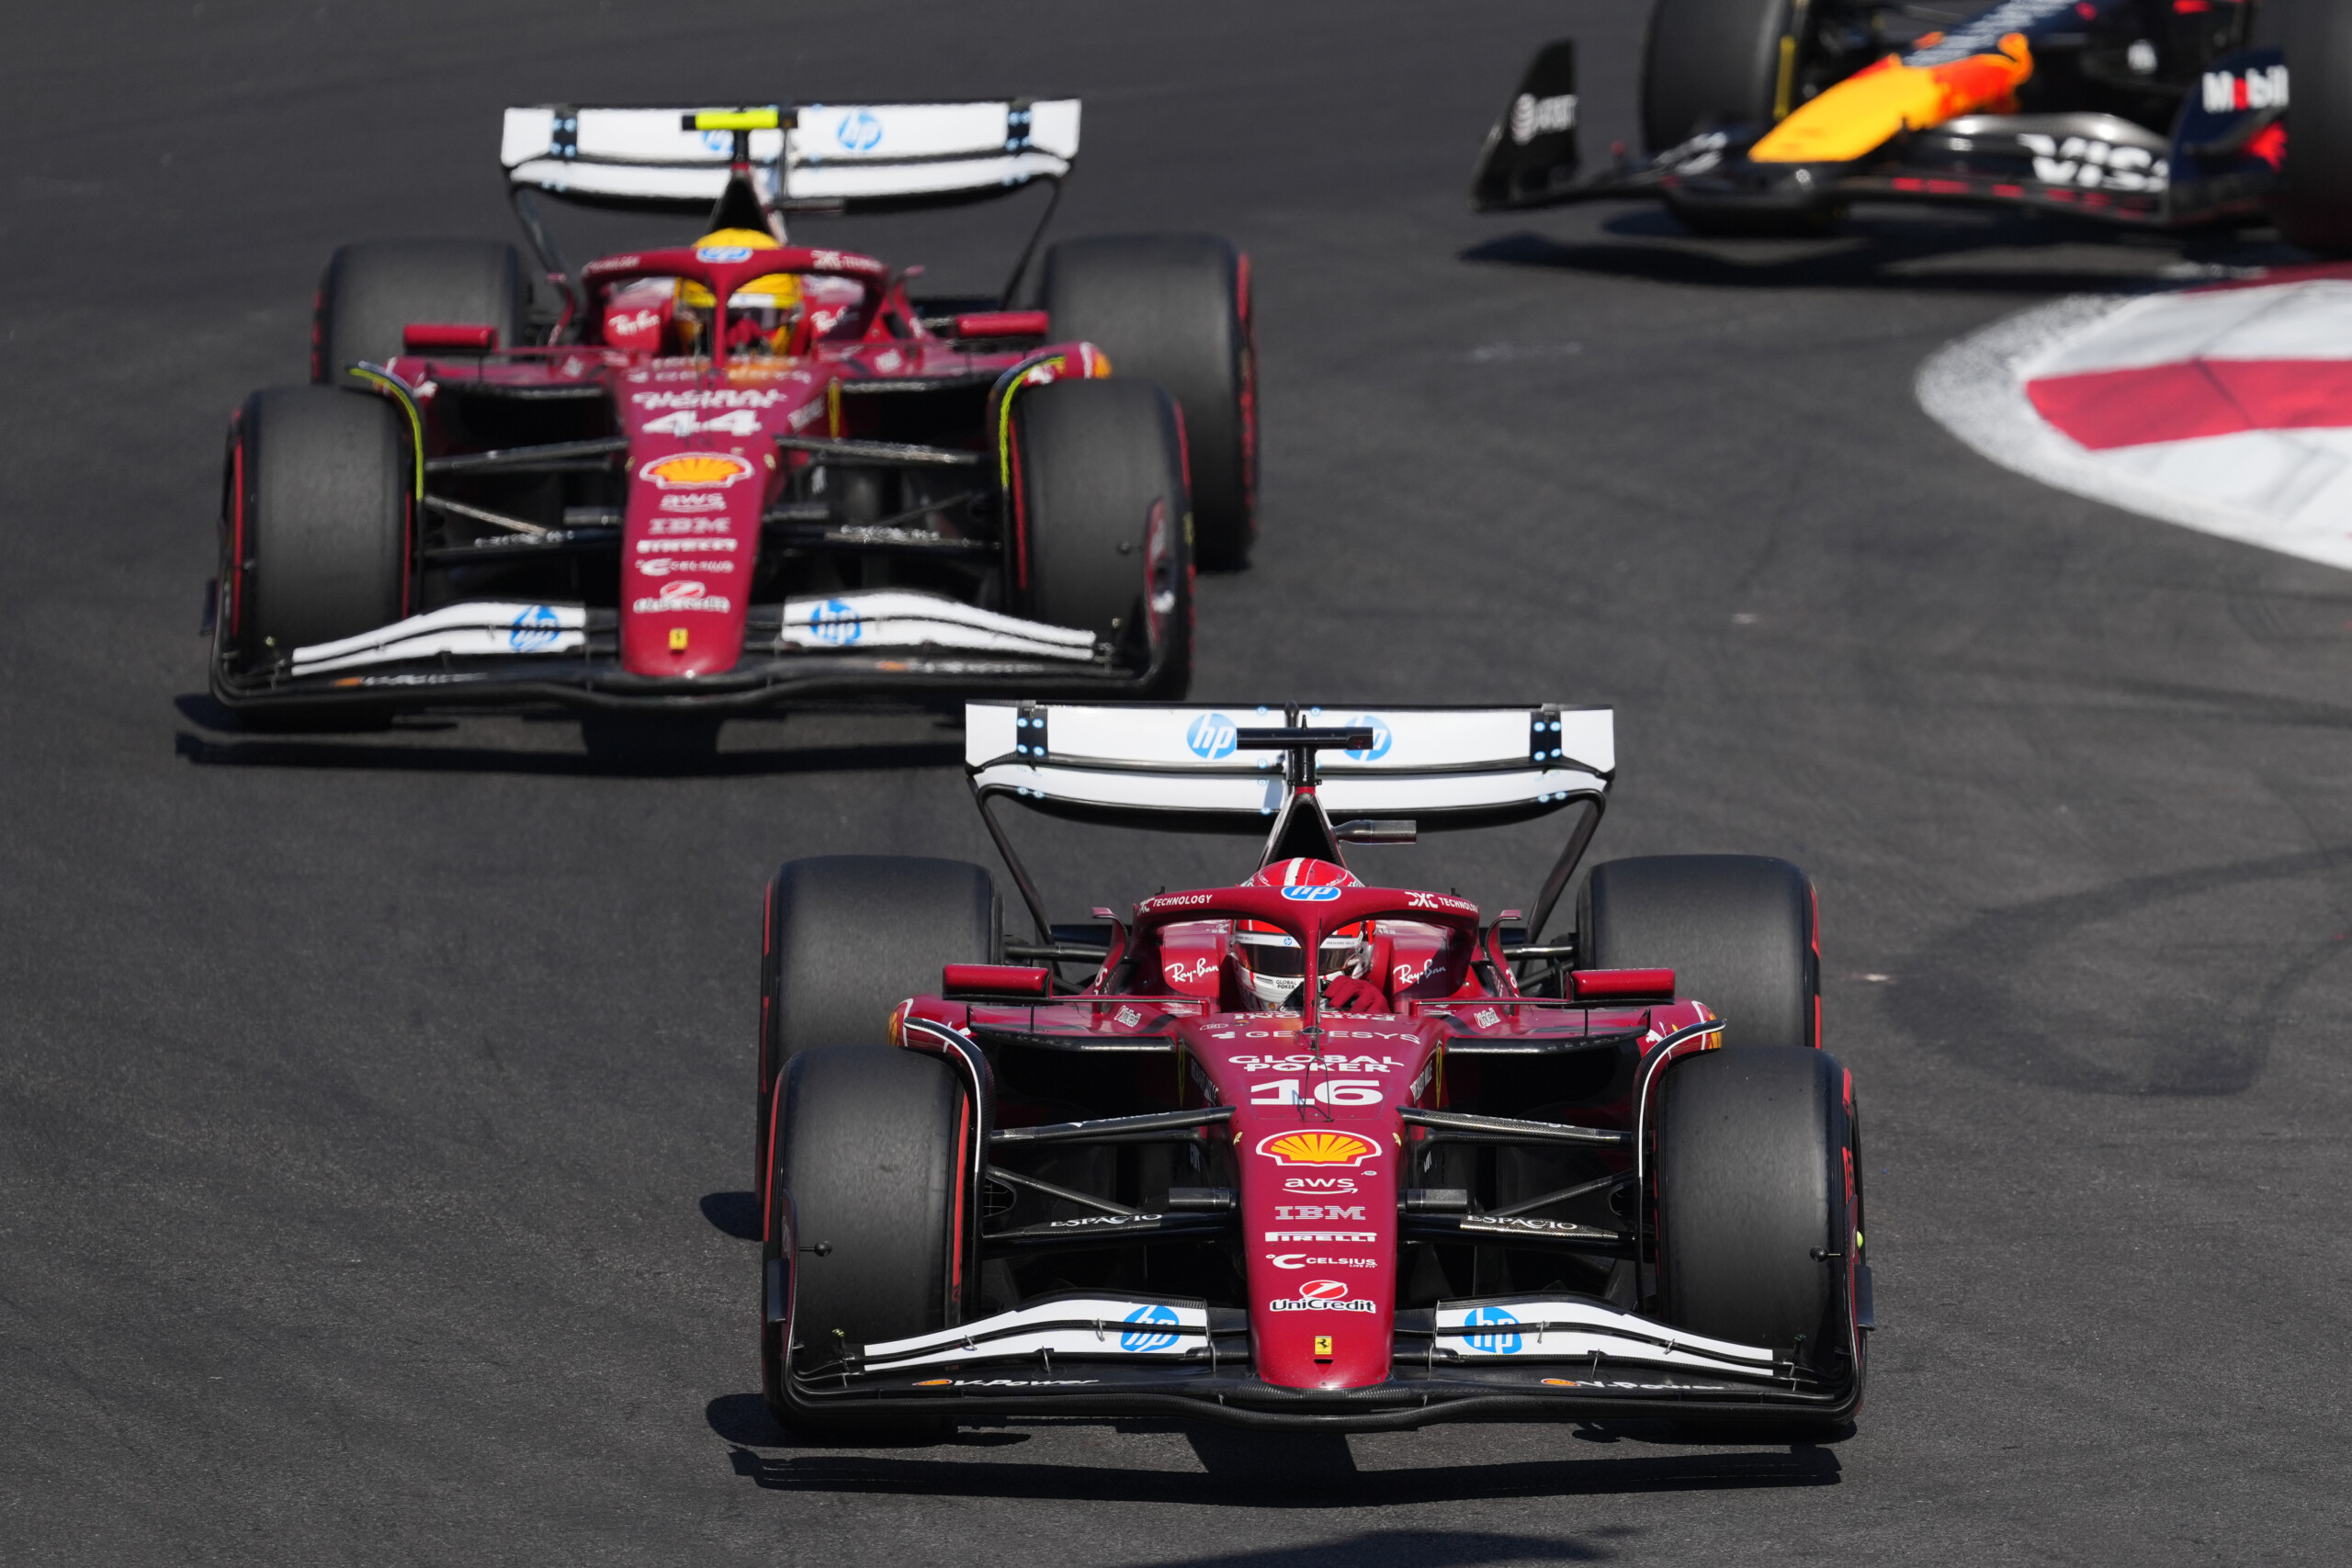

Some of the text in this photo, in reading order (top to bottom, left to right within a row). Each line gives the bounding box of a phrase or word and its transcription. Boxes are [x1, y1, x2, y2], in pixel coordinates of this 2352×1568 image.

[839, 111, 882, 151] hp
[642, 409, 763, 437] 44
[1188, 713, 1237, 760] hp
[1152, 894, 1213, 907] TECHNOLOGY
[1165, 958, 1219, 983] Ray-Ban
[1393, 958, 1446, 984] Ray-Ban
[1245, 1030, 1420, 1044] GEESYS
[1228, 1055, 1405, 1067] GLOBAL
[1243, 1063, 1391, 1073] POKER
[1250, 1078, 1384, 1106] 16
[1284, 1178, 1355, 1188] aws
[1050, 1213, 1162, 1227] ESPACIO
[1274, 1205, 1366, 1221] IBM
[1467, 1214, 1577, 1230] ESPACIO
[1265, 1231, 1377, 1242] PIRELLI
[1306, 1257, 1377, 1266] CELSIUS
[1270, 1299, 1376, 1314] UniCredit
[1121, 1304, 1179, 1352] hp
[1465, 1306, 1521, 1355] hp
[954, 1379, 1100, 1387] V-Power
